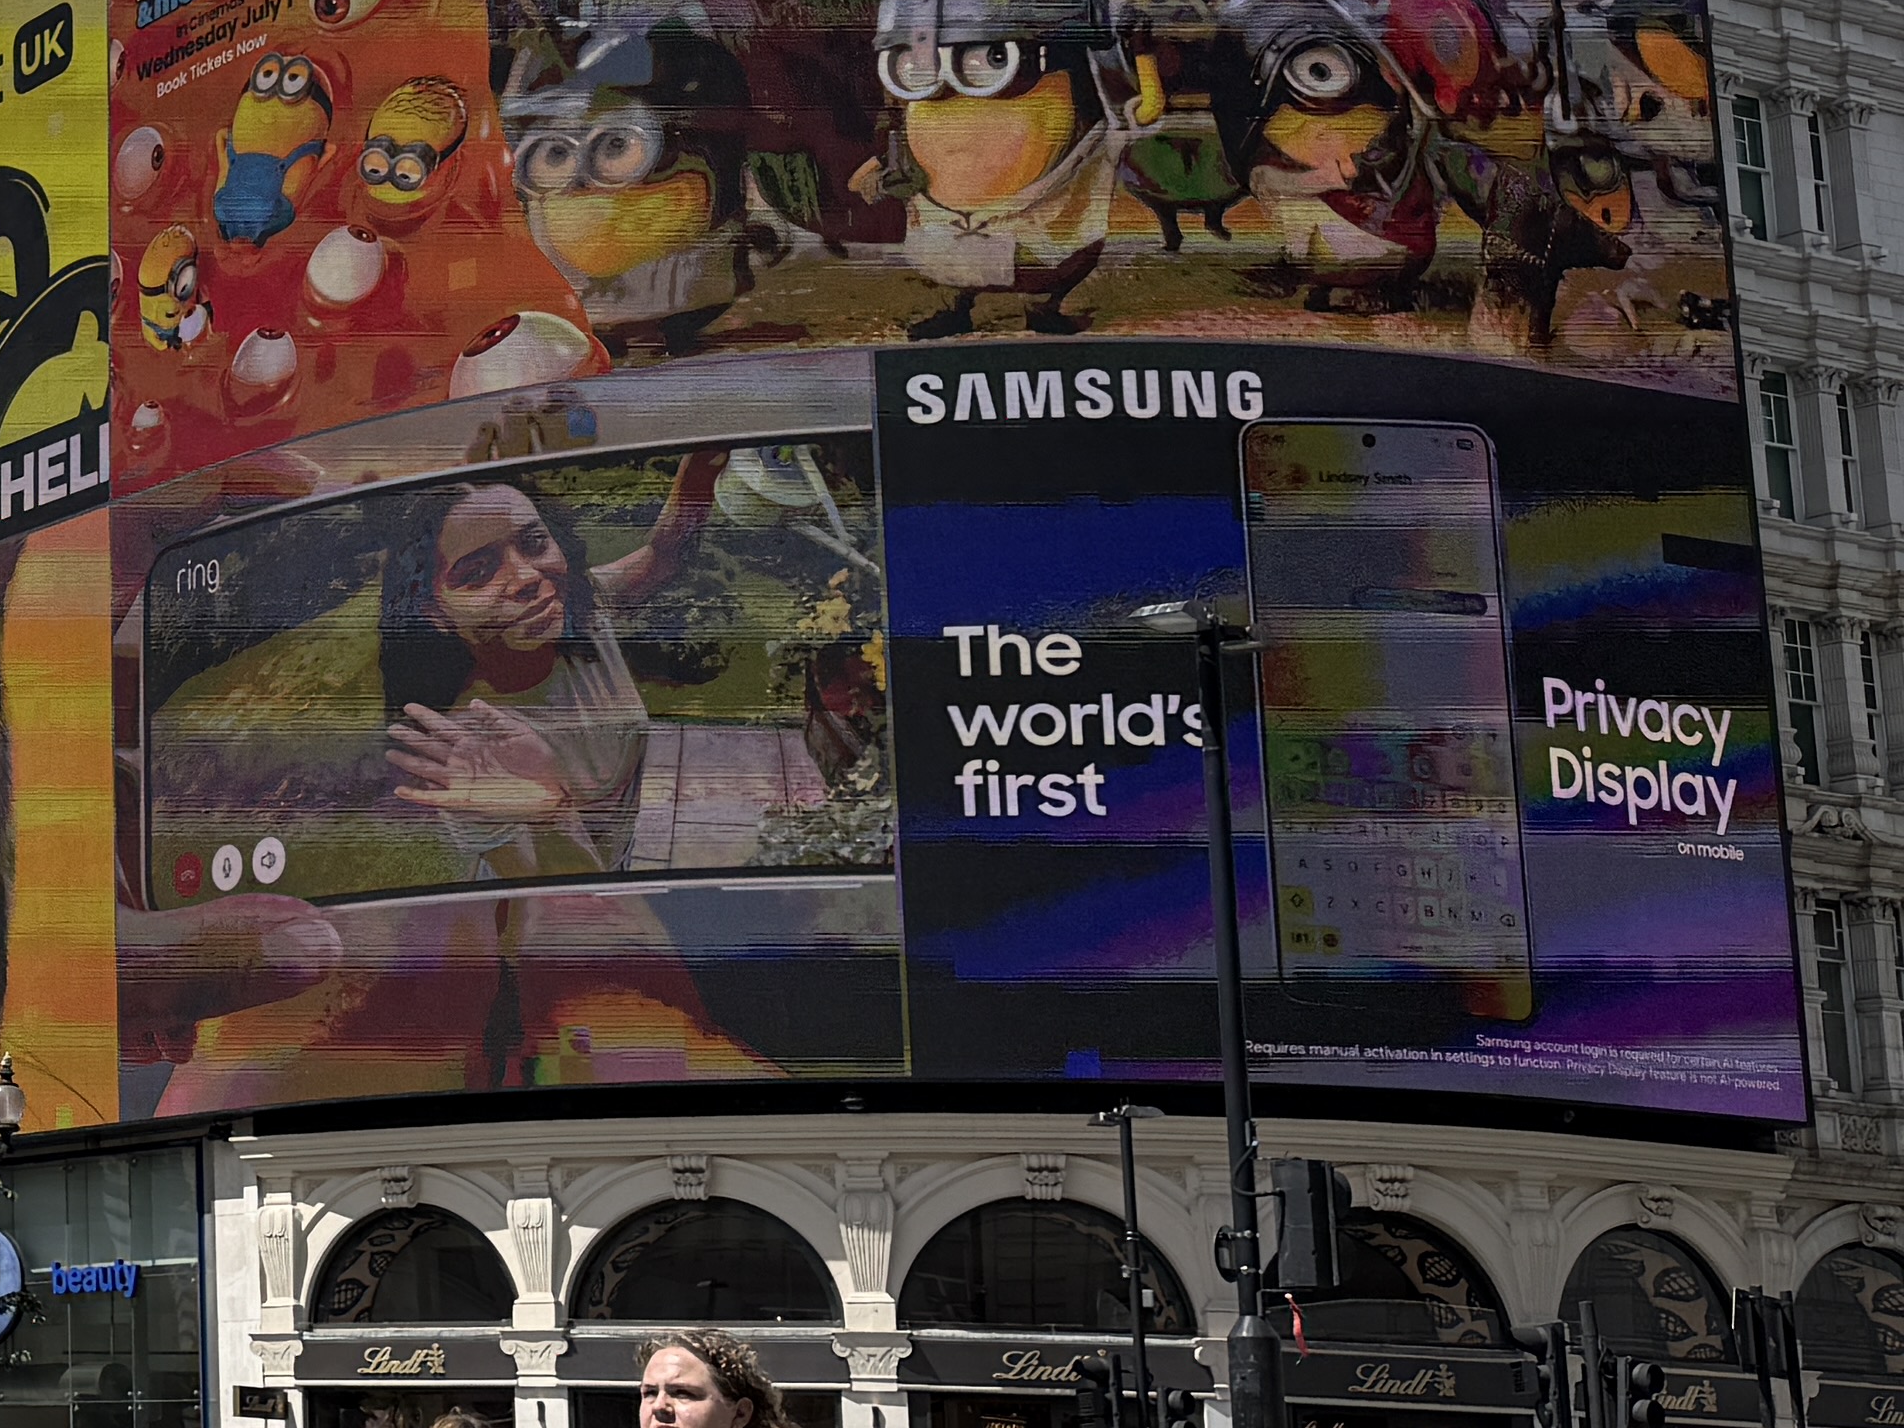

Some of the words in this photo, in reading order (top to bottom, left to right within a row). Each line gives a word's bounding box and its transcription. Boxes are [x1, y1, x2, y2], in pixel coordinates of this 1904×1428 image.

[20, 20, 65, 76] UK
[137, 18, 238, 81] Wednesday
[156, 72, 188, 98] Book
[190, 47, 234, 81] Tickets
[236, 33, 268, 56] Now
[905, 368, 1265, 424] SAMSUNG
[176, 559, 220, 593] ring
[943, 624, 1083, 677] The
[1542, 676, 1732, 767] Privacy
[954, 759, 1107, 817] first
[1549, 745, 1737, 836] Display
[1677, 841, 1696, 855] on
[1697, 842, 1745, 861] mobile
[1309, 1043, 1360, 1057] manual
[1364, 1045, 1428, 1060] activation
[1445, 1051, 1496, 1067] settings
[1498, 1054, 1511, 1066] to
[1566, 1058, 1605, 1077] Privacy
[1607, 1061, 1646, 1081] Display
[1475, 1034, 1532, 1053] Samsung
[1533, 1041, 1579, 1054] account
[1580, 1043, 1607, 1059] login
[51, 1259, 141, 1298] beauty
[357, 1346, 430, 1374] Lindt
[1347, 1363, 1434, 1396] Lindt
